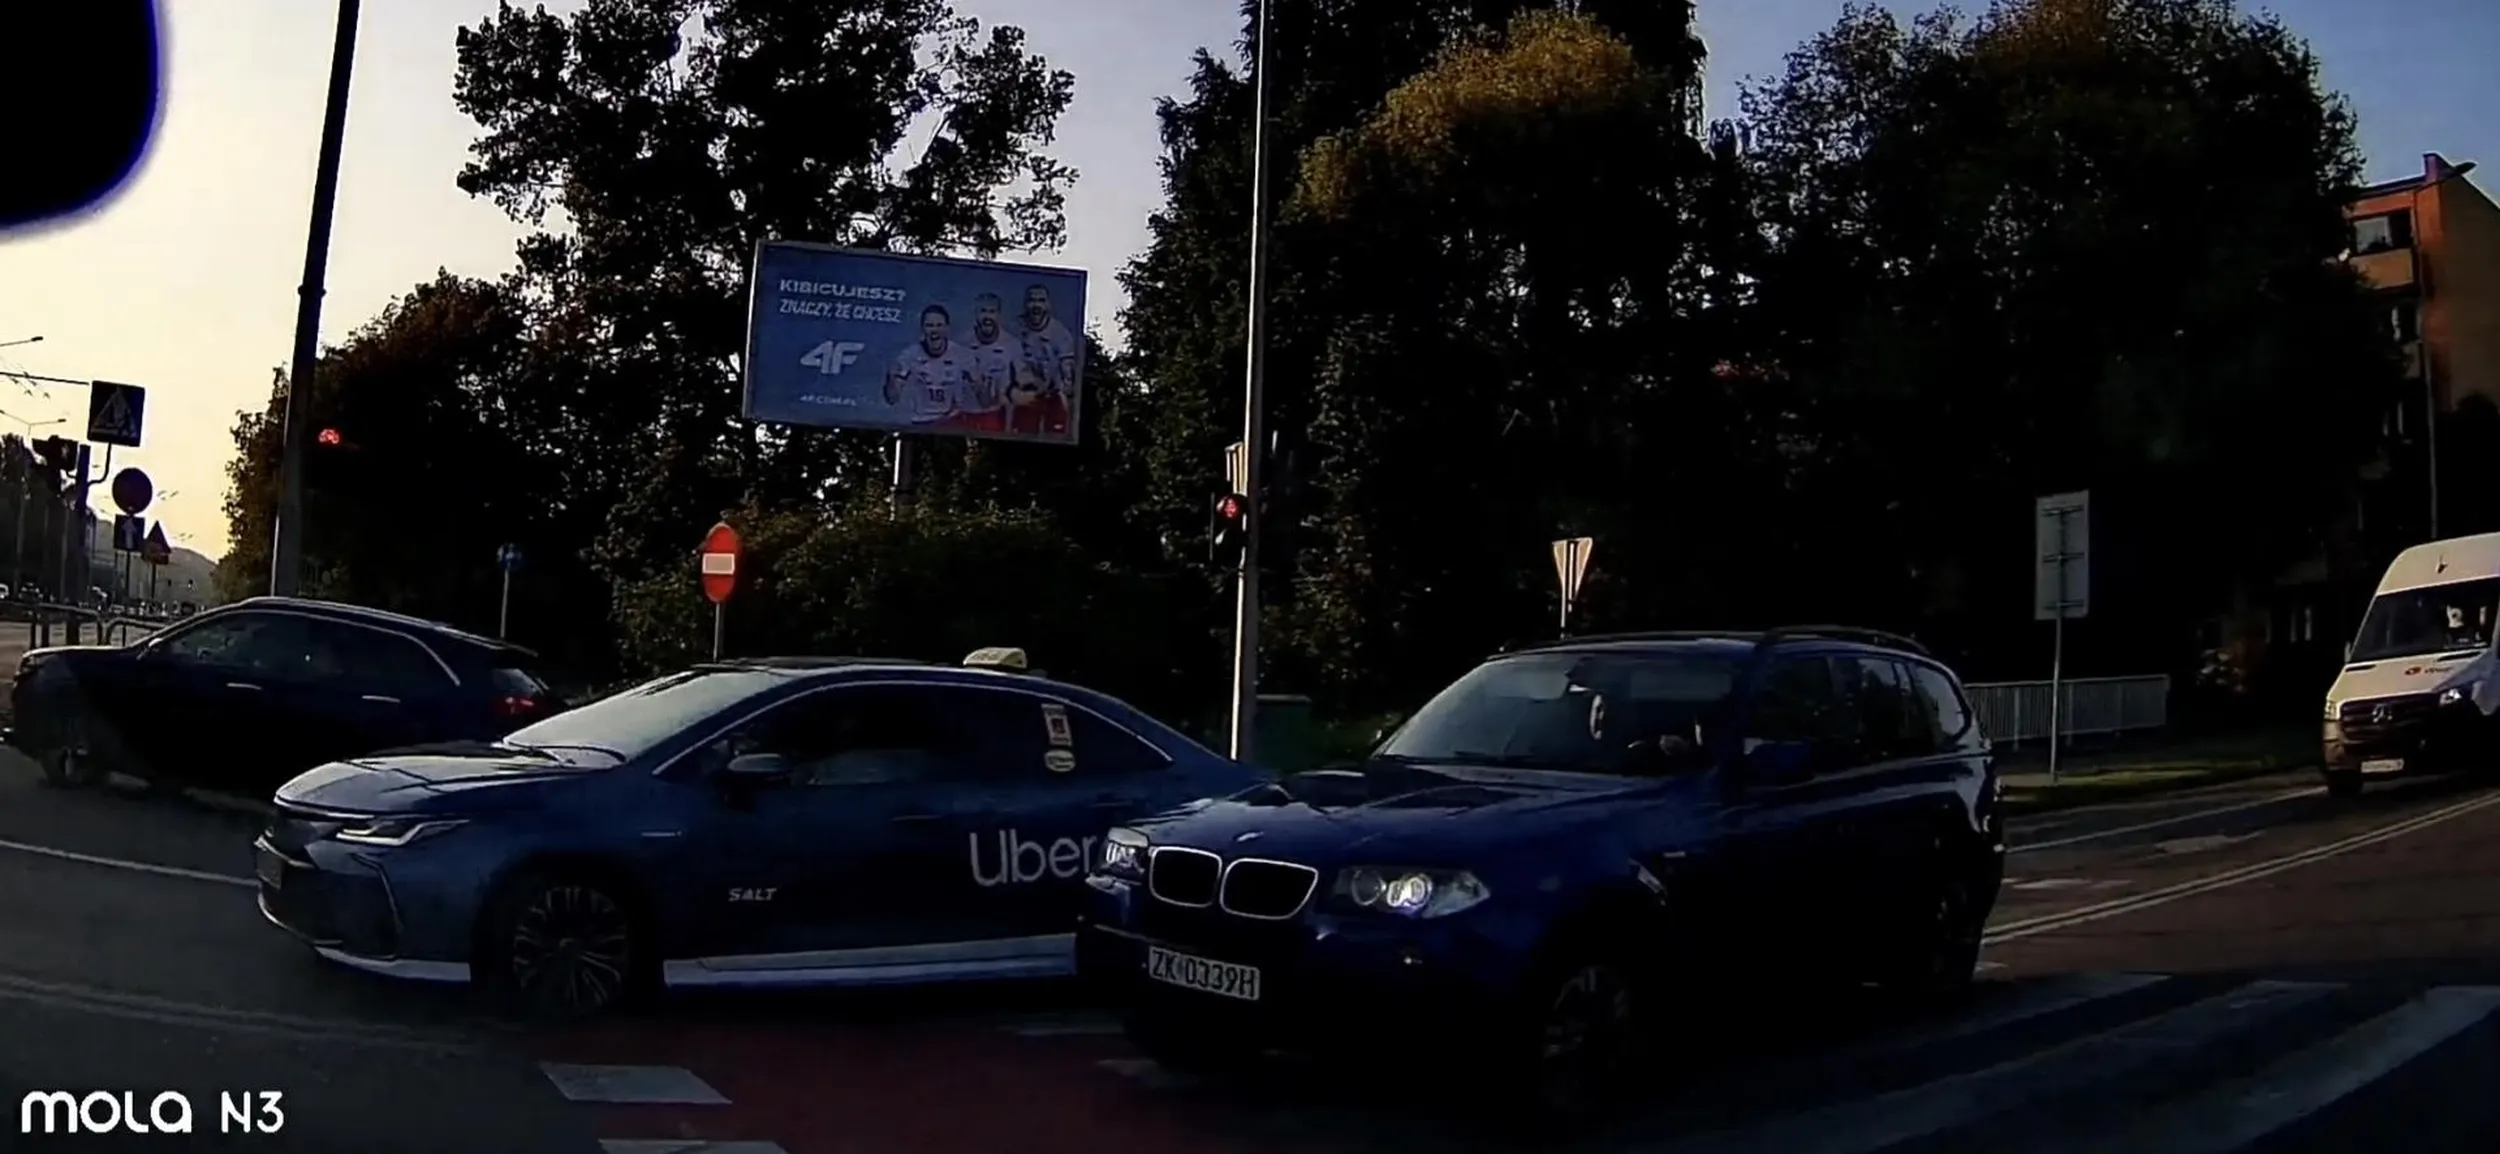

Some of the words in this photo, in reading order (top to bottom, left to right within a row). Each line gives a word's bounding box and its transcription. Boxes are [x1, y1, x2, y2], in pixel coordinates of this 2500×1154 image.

[779, 279, 907, 301] KIBICUJESZ?
[800, 340, 865, 374] 4F
[968, 828, 1098, 888] Uber
[728, 887, 778, 903] SALT
[1152, 949, 1177, 980] ZK
